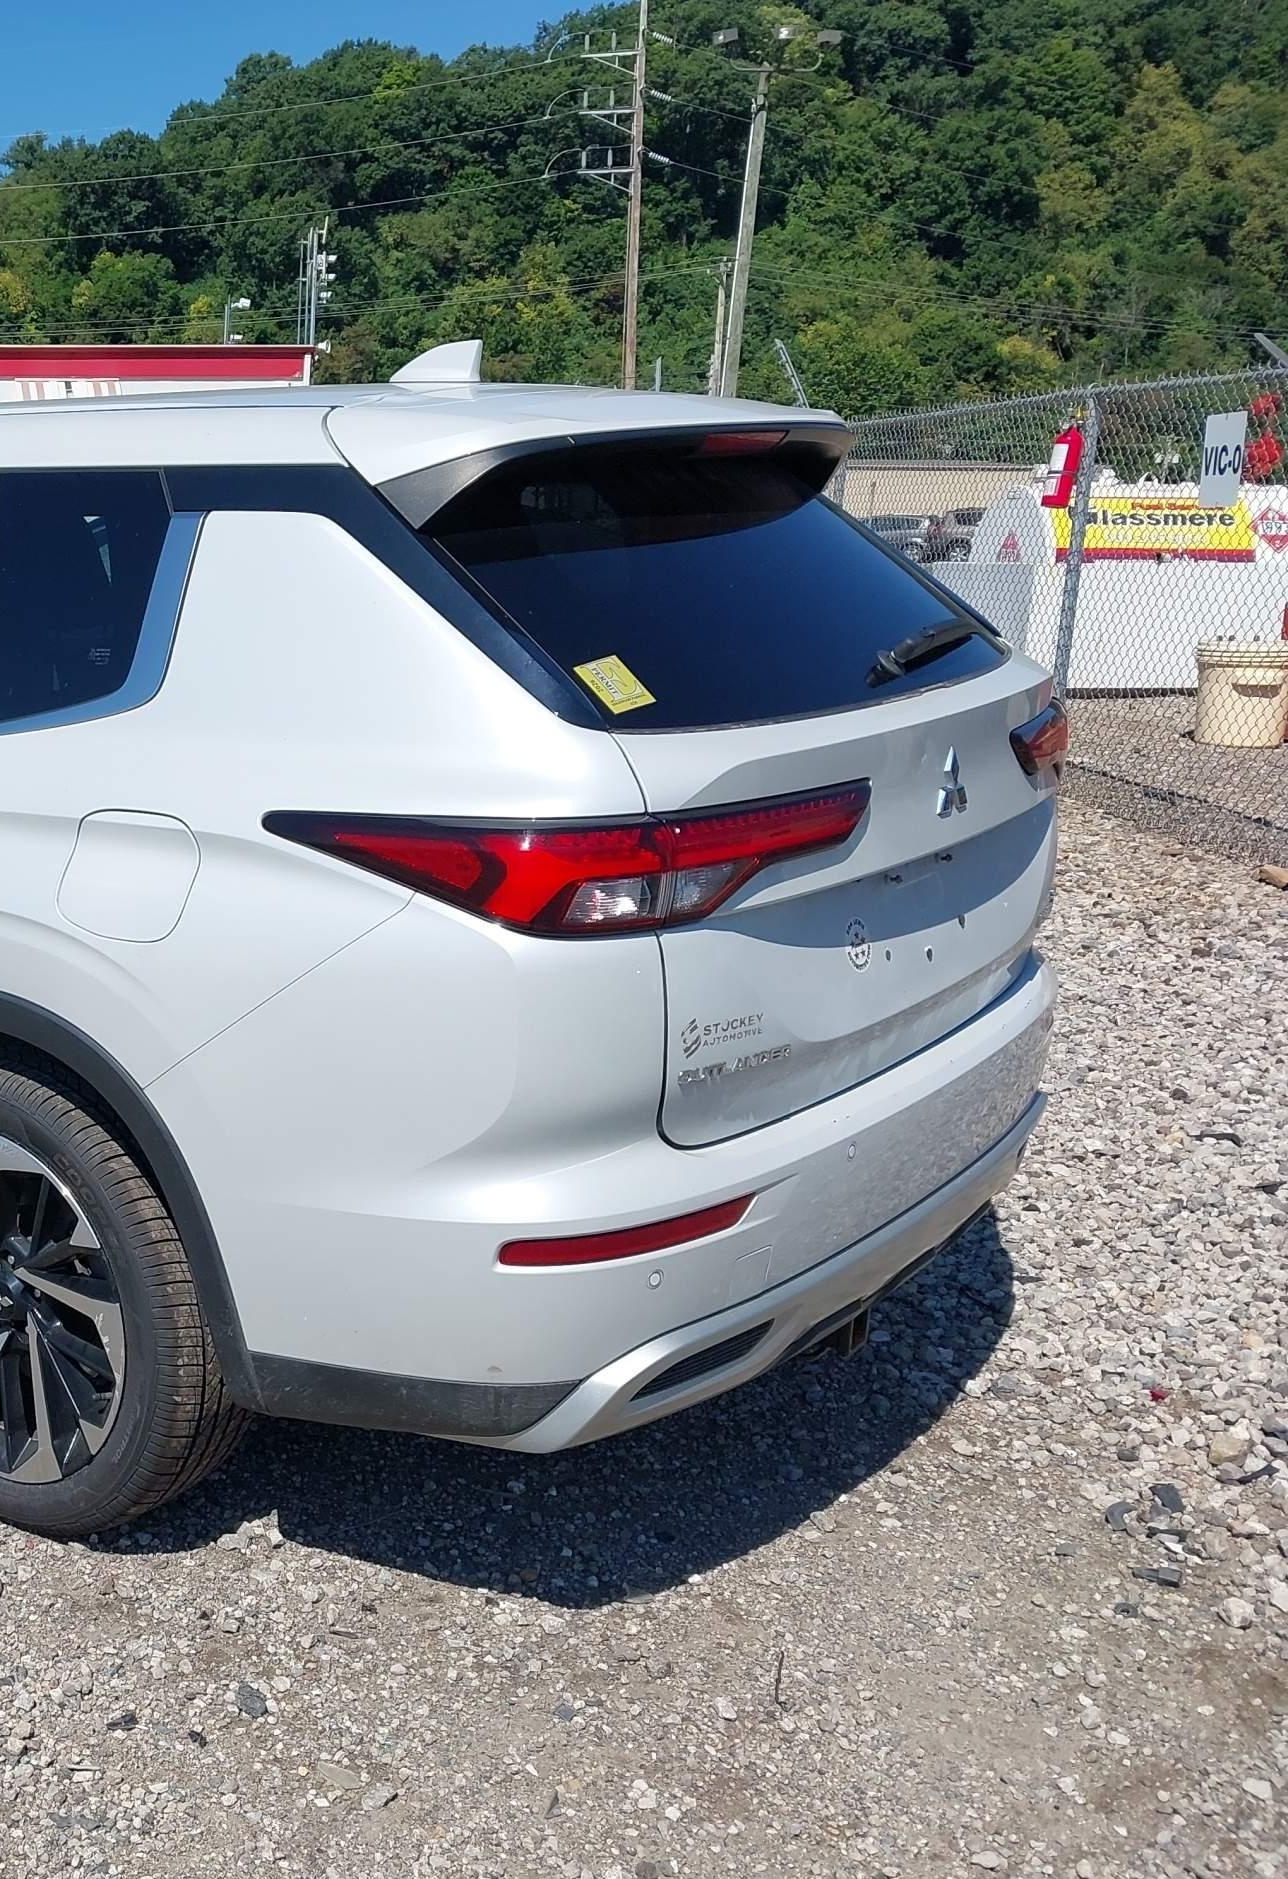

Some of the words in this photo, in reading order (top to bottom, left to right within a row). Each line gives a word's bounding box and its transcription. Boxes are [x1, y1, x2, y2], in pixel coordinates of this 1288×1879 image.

[591, 667, 618, 695] PERMIT
[702, 1027, 763, 1047] AUTOMOTIVE
[703, 1012, 764, 1036] STUCKEY
[678, 1044, 791, 1083] OUTLANDER
